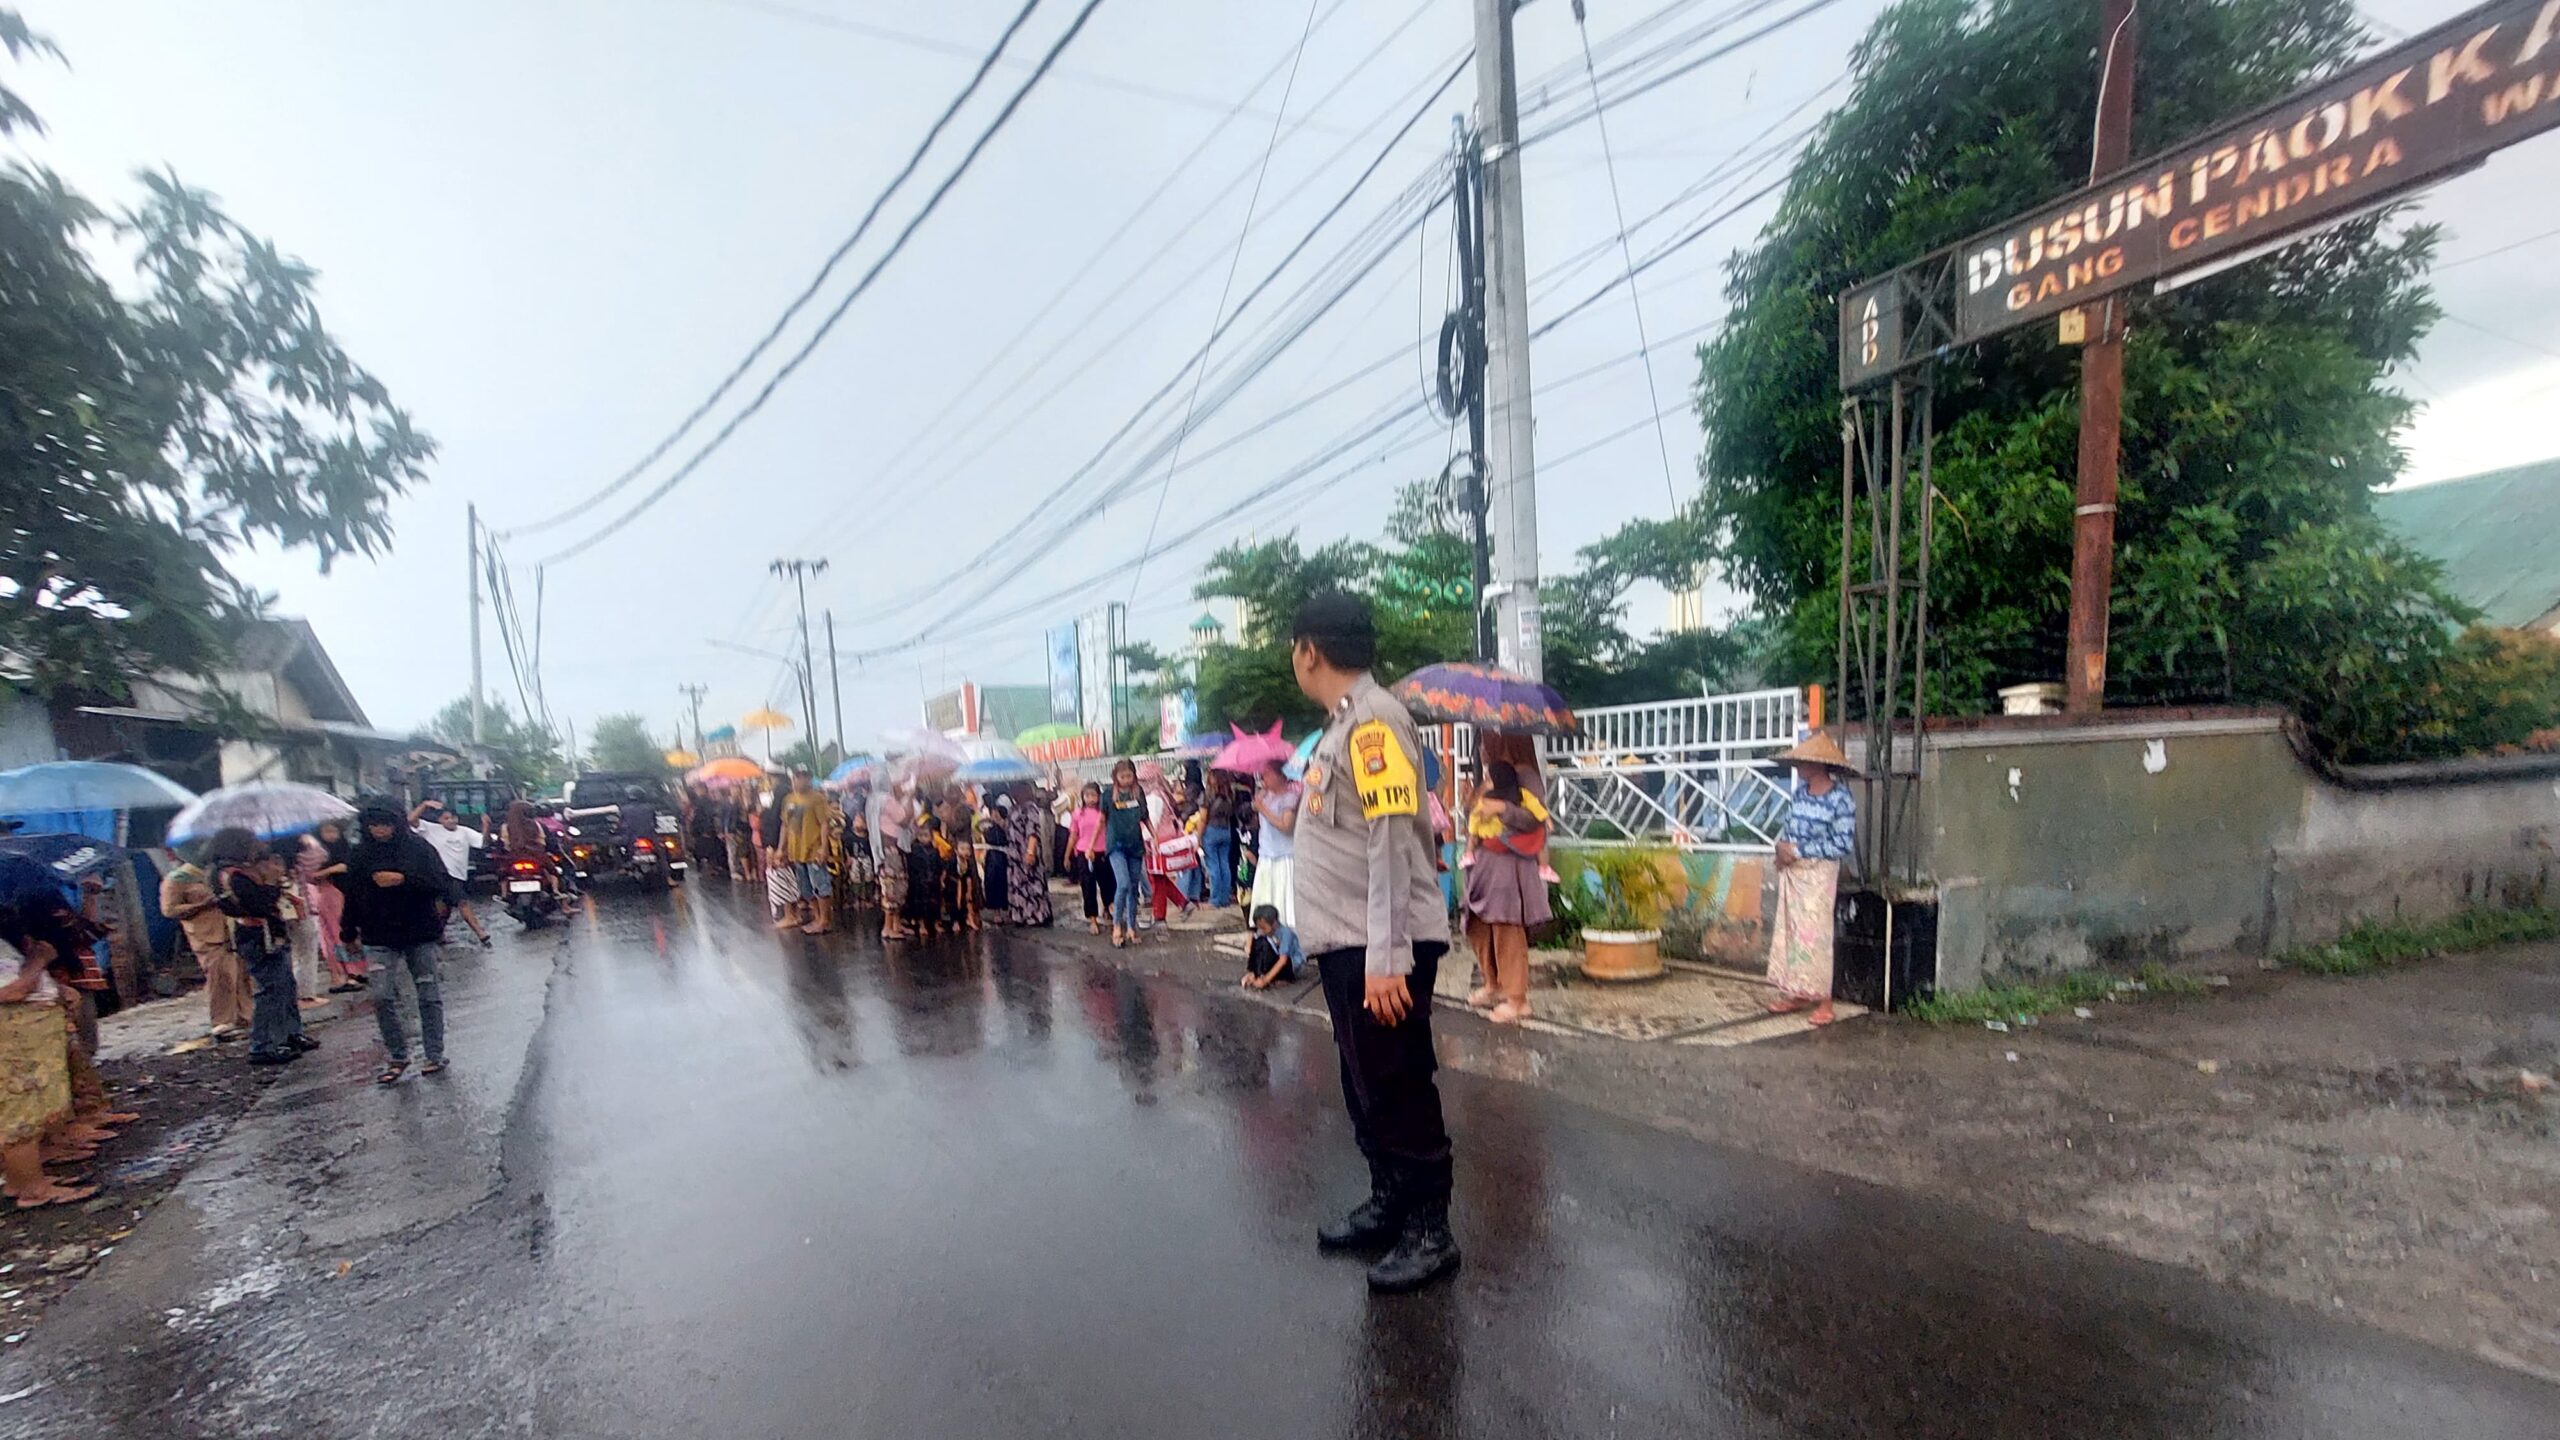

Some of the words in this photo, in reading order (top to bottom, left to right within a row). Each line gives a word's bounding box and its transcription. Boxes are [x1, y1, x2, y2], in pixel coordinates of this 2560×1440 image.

[1968, 170, 2175, 296] DUSUN
[2006, 246, 2125, 312] GANG
[2168, 136, 2403, 250] CENDRA
[2482, 71, 2560, 127] W
[1383, 785, 1411, 806] TPS
